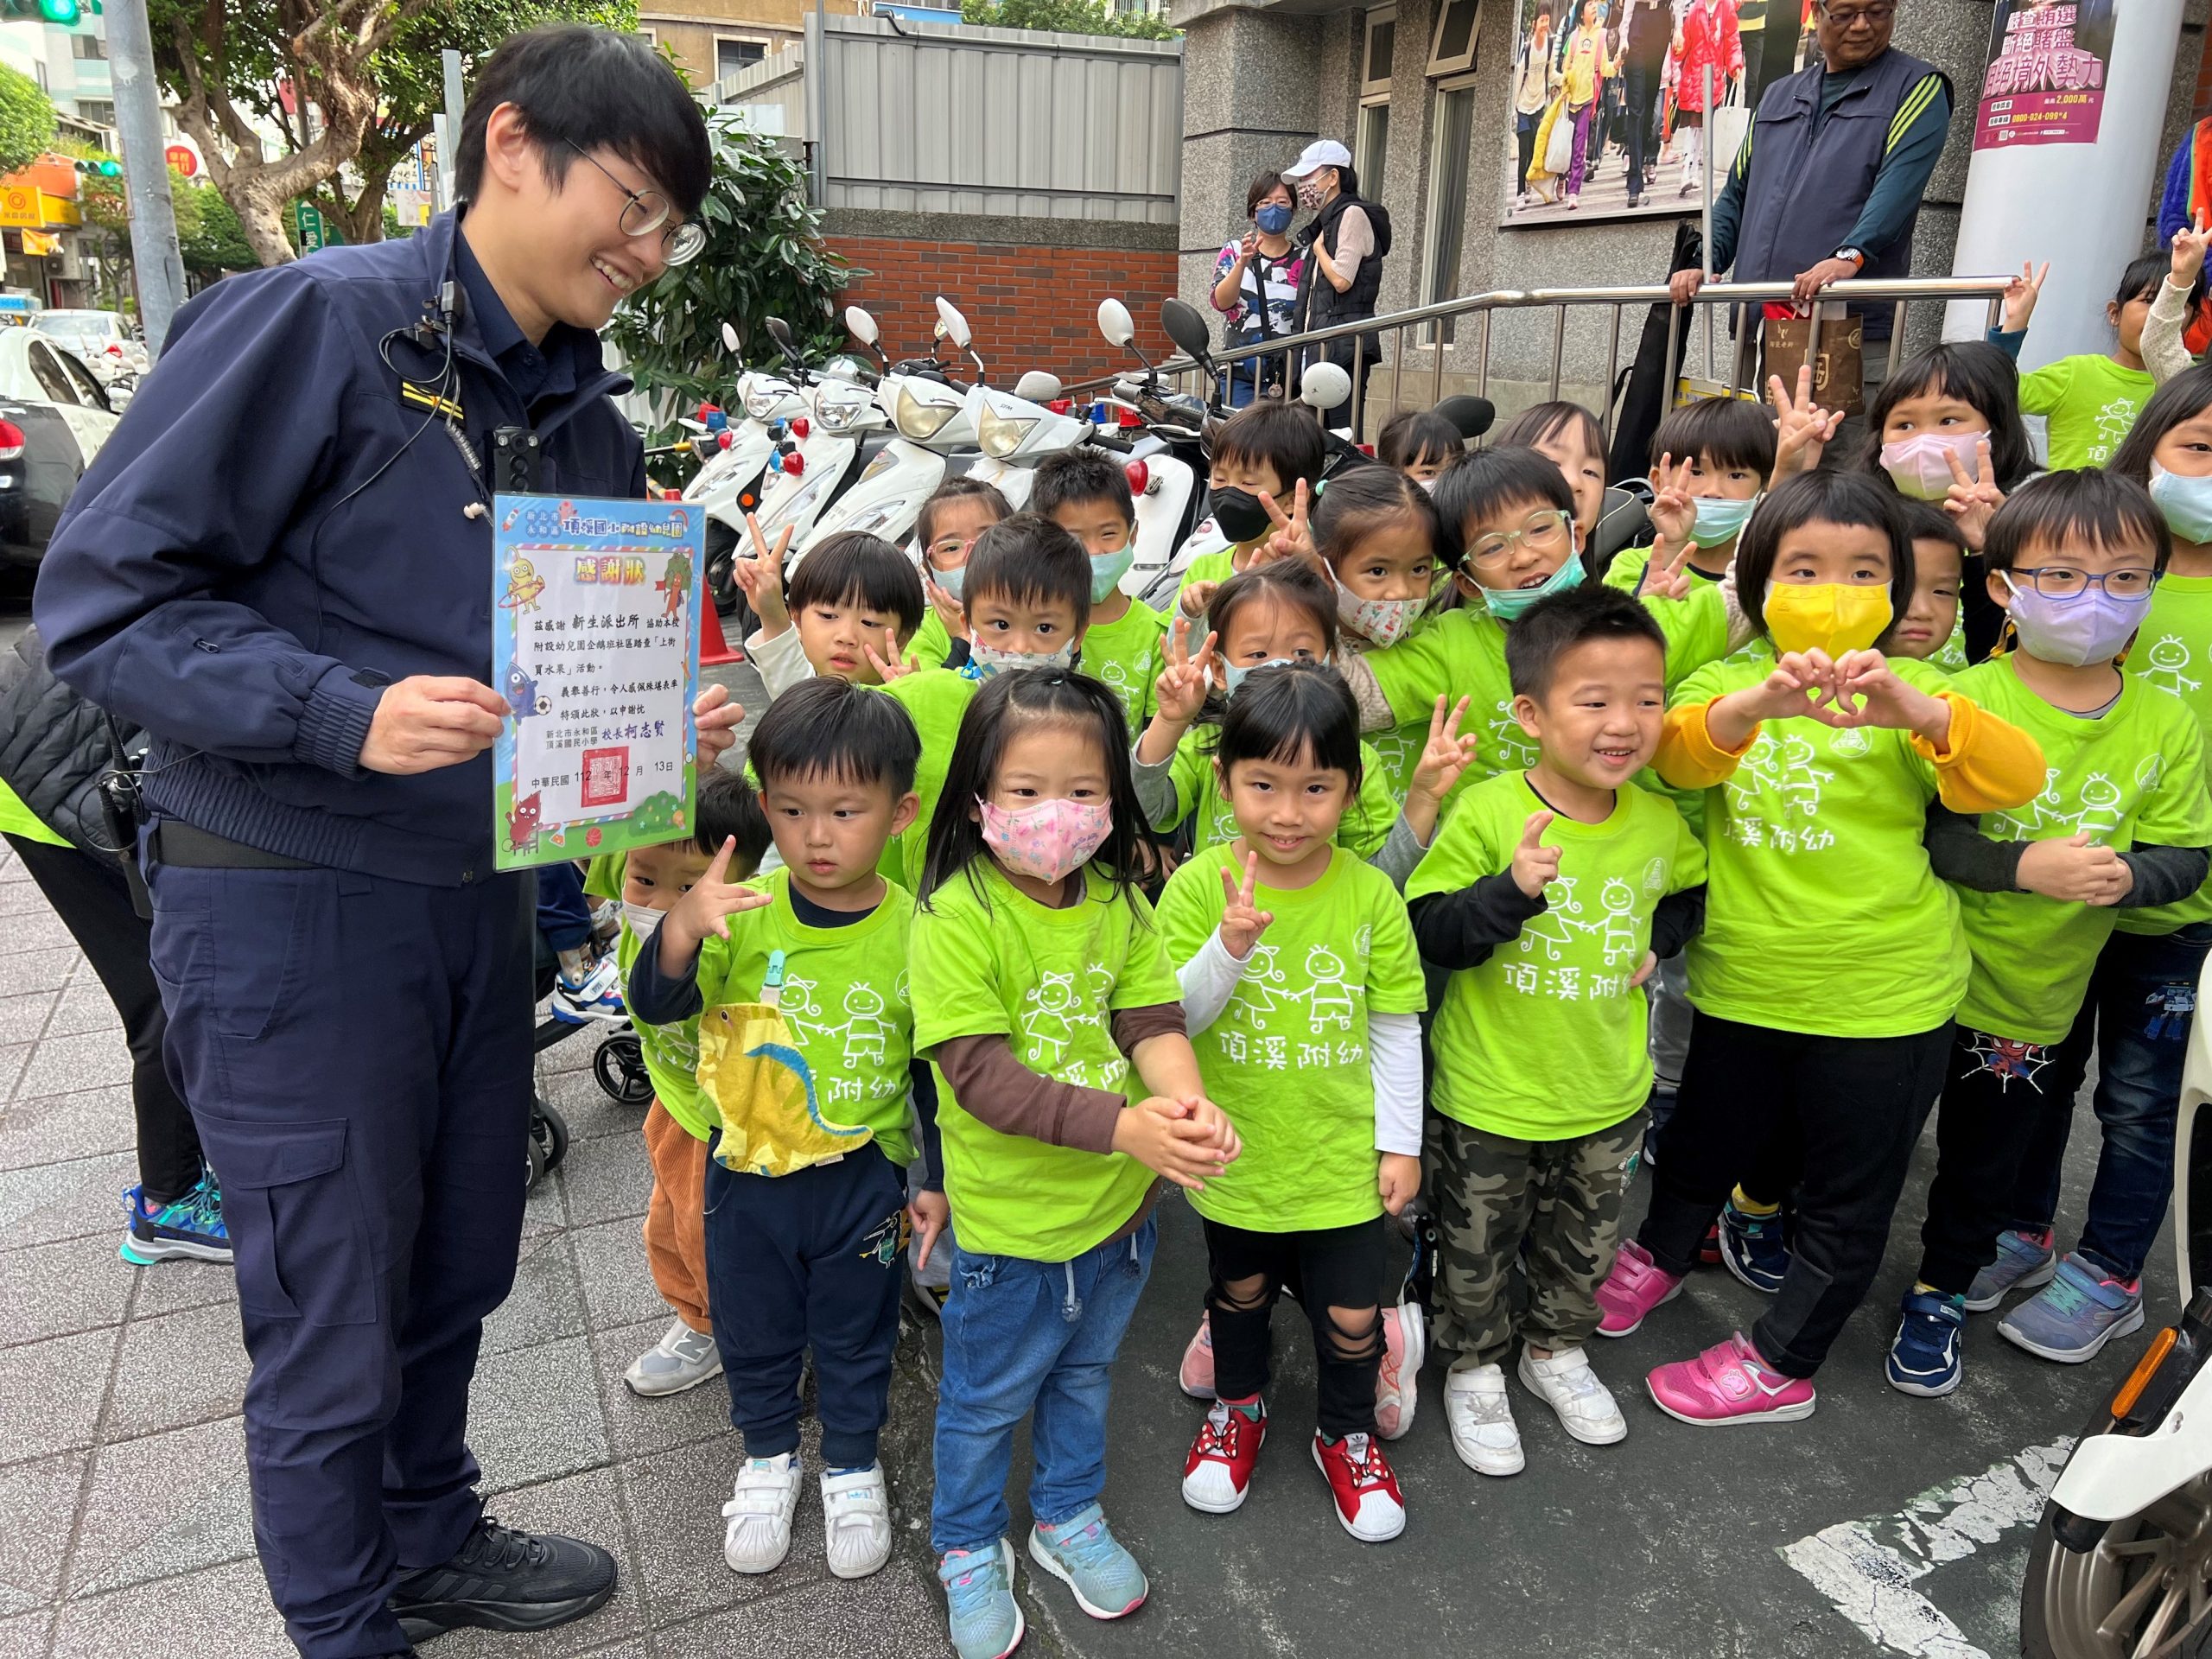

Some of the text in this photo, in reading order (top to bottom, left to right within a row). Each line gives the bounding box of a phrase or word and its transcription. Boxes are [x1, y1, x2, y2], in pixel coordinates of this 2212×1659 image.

[2006, 4, 2077, 30] 嚴查賄選
[2001, 28, 2075, 55] 斷絕賭盤
[527, 511, 559, 521] 新北市
[575, 556, 646, 585] 感謝狀
[571, 613, 639, 631] 新生派出所
[646, 618, 680, 629] 協助本校
[545, 736, 598, 750] 頂溪國民小學
[546, 726, 598, 739] 新北市永和區
[531, 774, 569, 789] 中華民國
[575, 770, 592, 782] 112
[620, 766, 630, 777] 12
[635, 766, 643, 777] 月
[1219, 1030, 1363, 1070] 頂溪附幼
[809, 1070, 896, 1103] 附幼
